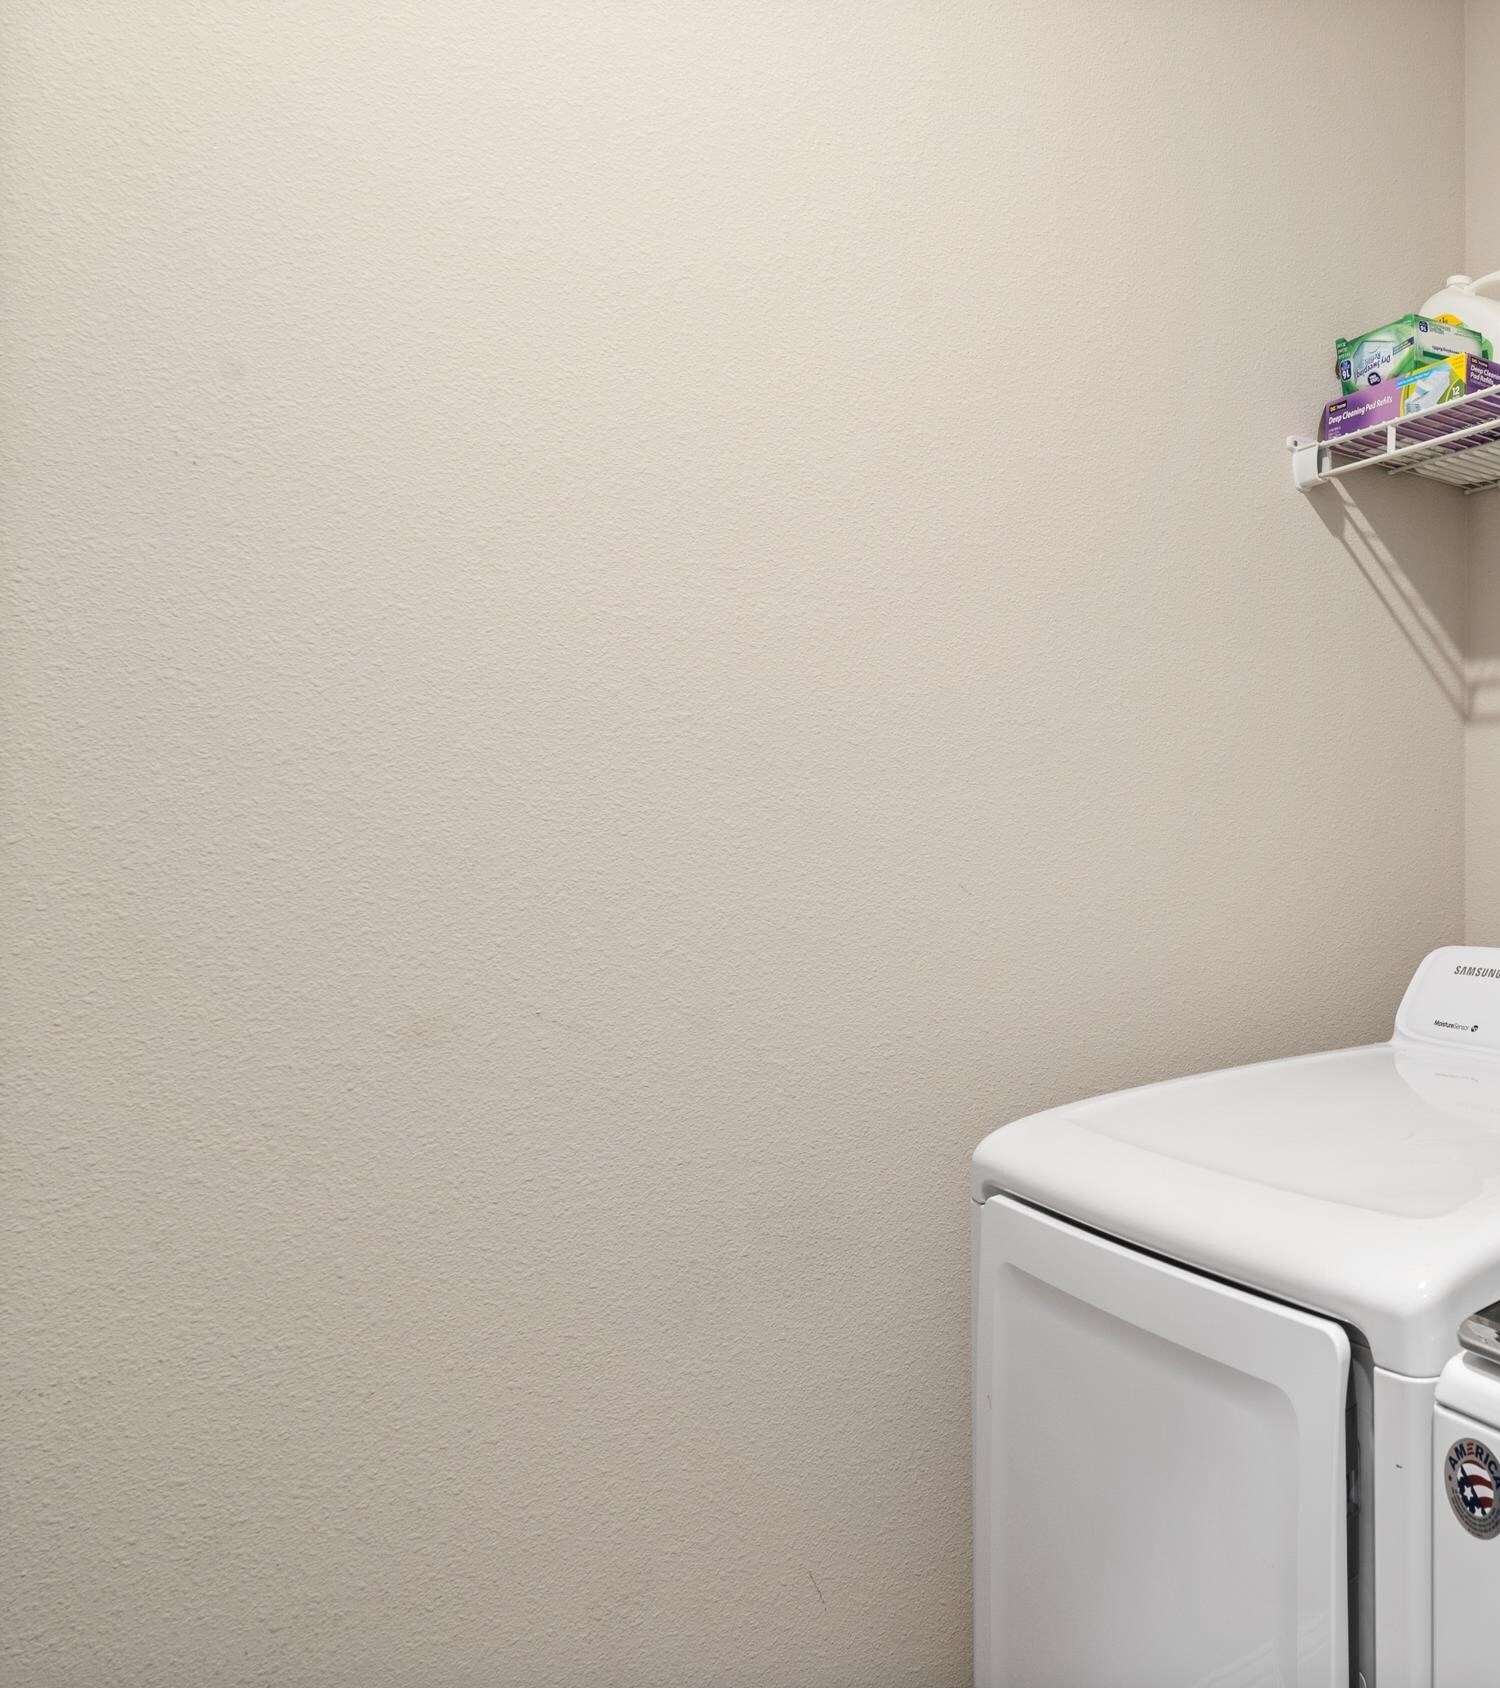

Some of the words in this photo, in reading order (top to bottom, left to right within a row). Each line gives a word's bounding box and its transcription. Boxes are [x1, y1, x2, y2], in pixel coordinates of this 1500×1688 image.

[1452, 386, 1460, 395] 12
[1328, 414, 1342, 425] Deep
[1342, 406, 1365, 419] Cleaning
[1365, 402, 1376, 412] Pad
